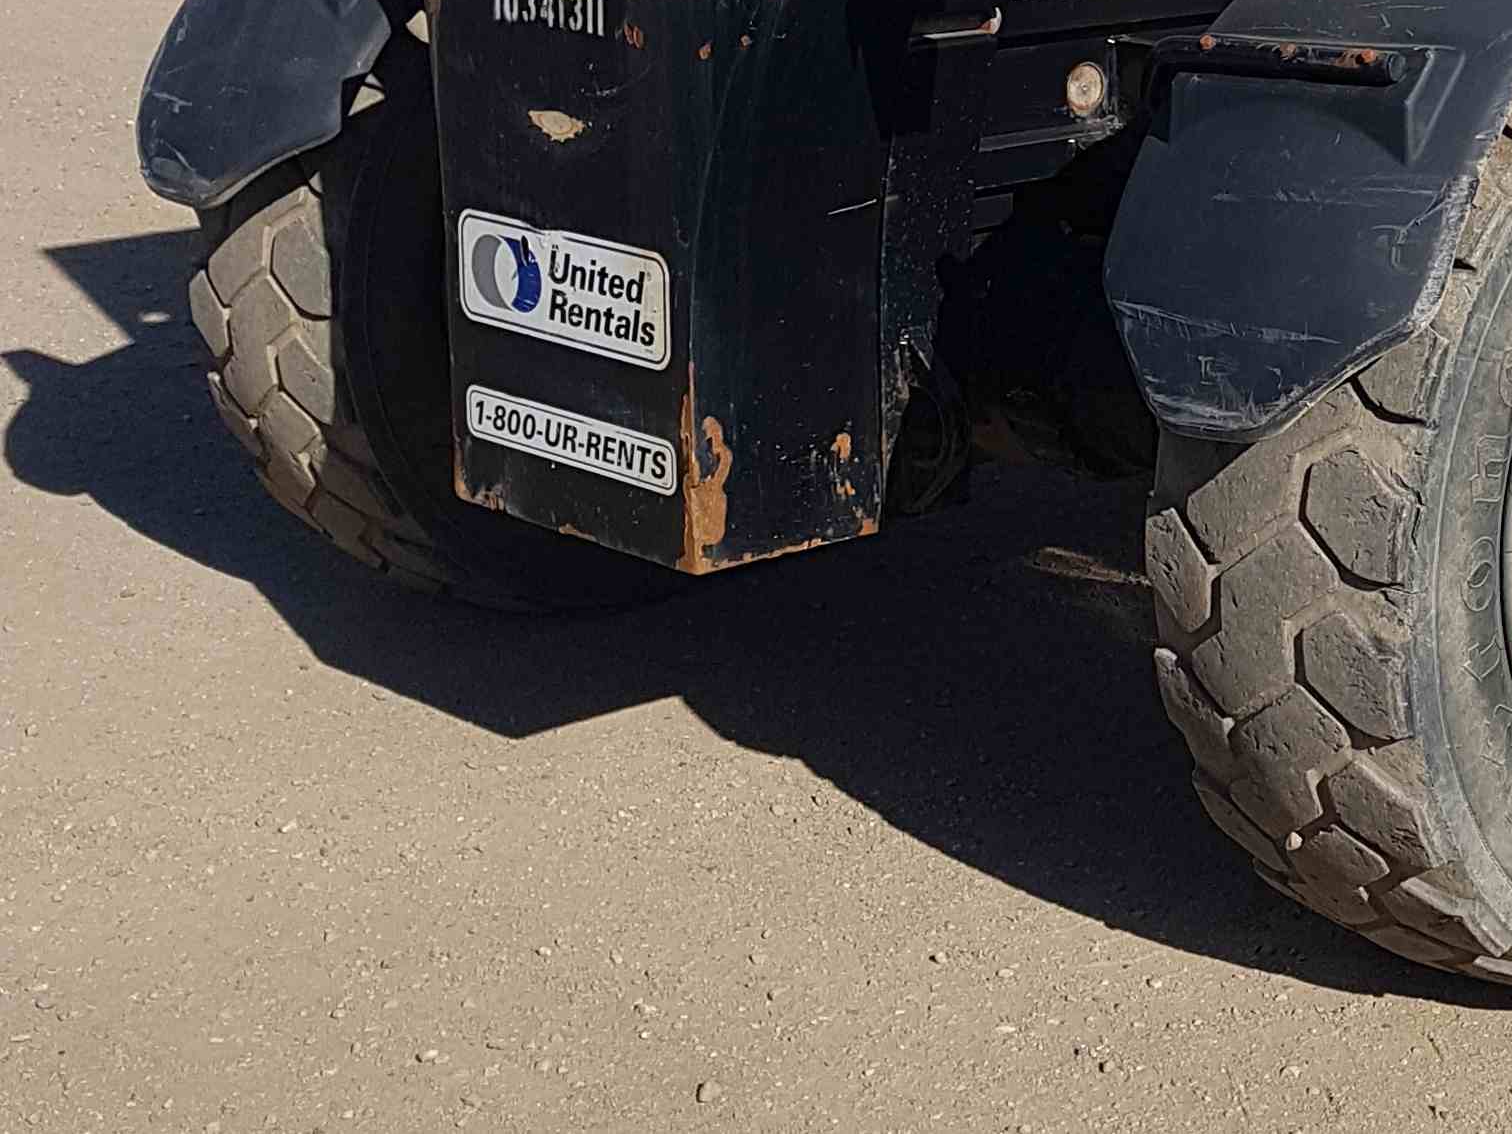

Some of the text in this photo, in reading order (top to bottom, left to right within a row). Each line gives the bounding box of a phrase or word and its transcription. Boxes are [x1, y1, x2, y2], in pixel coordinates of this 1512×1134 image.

[548, 247, 646, 304] United
[548, 289, 656, 347] Rentals
[475, 400, 667, 479] 1-800-UR-RENTS
